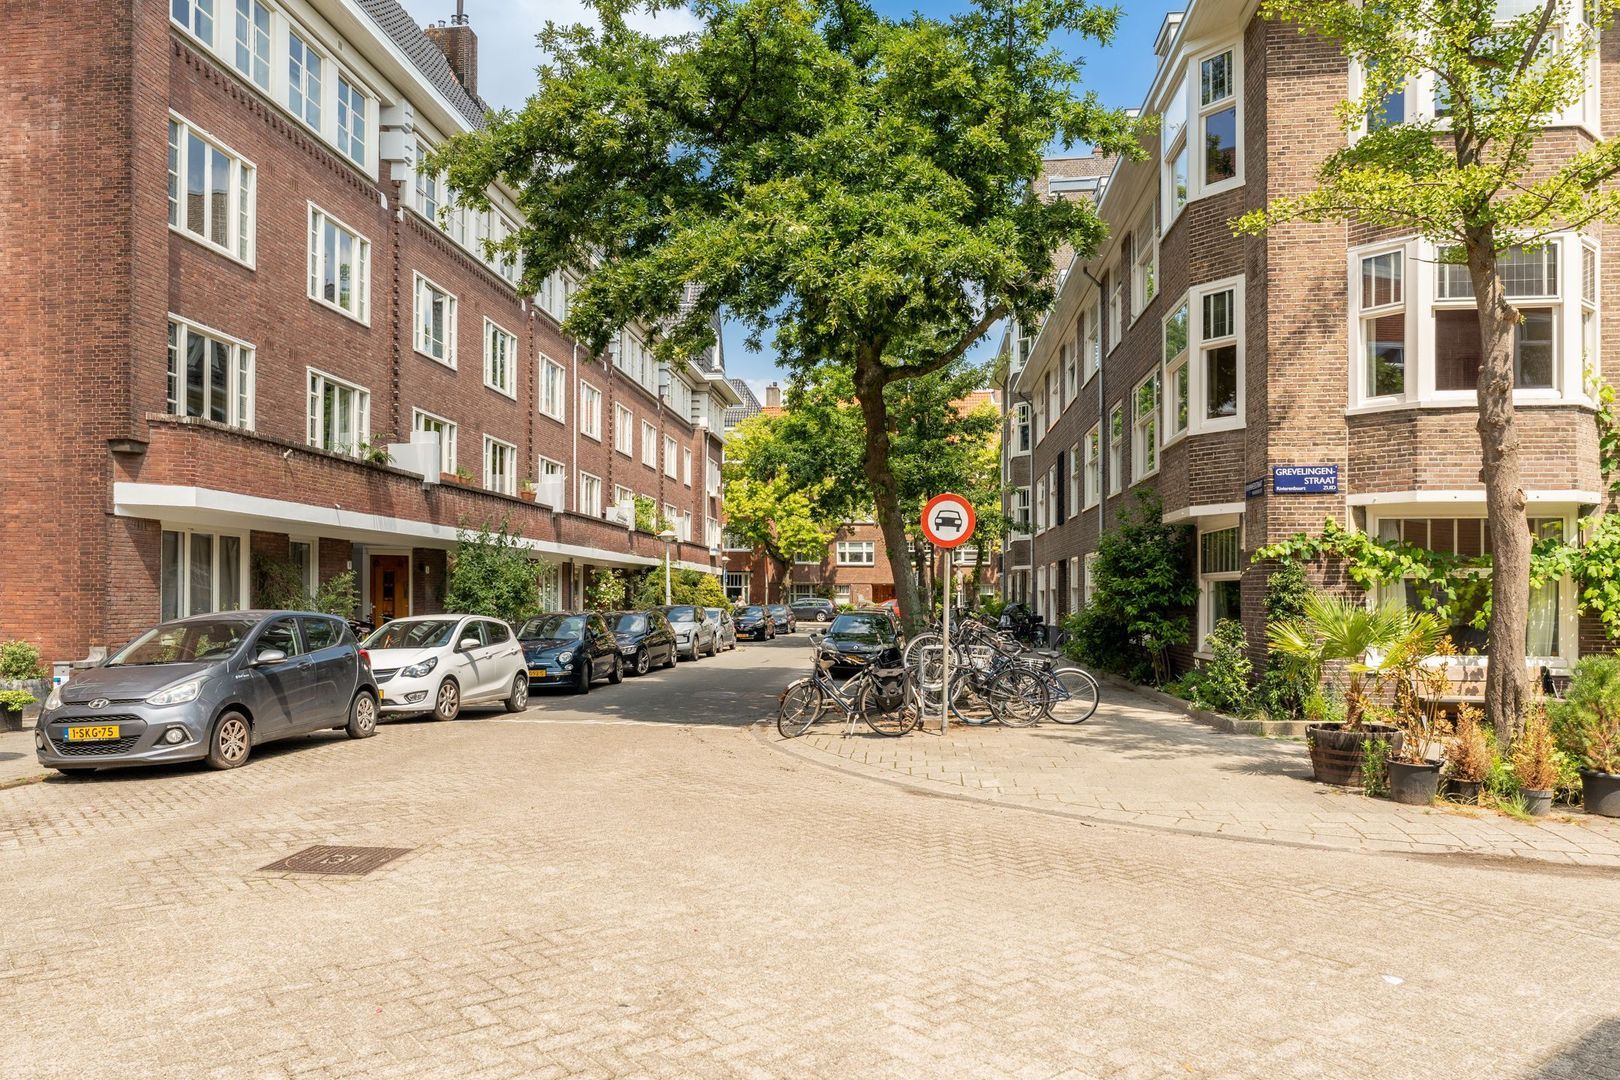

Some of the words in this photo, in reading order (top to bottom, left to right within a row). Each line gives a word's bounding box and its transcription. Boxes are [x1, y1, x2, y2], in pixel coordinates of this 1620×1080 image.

[1275, 468, 1336, 476] GREVELINGEN-
[1304, 477, 1336, 485] STRAAT
[72, 727, 114, 738] 1-SKG-75
